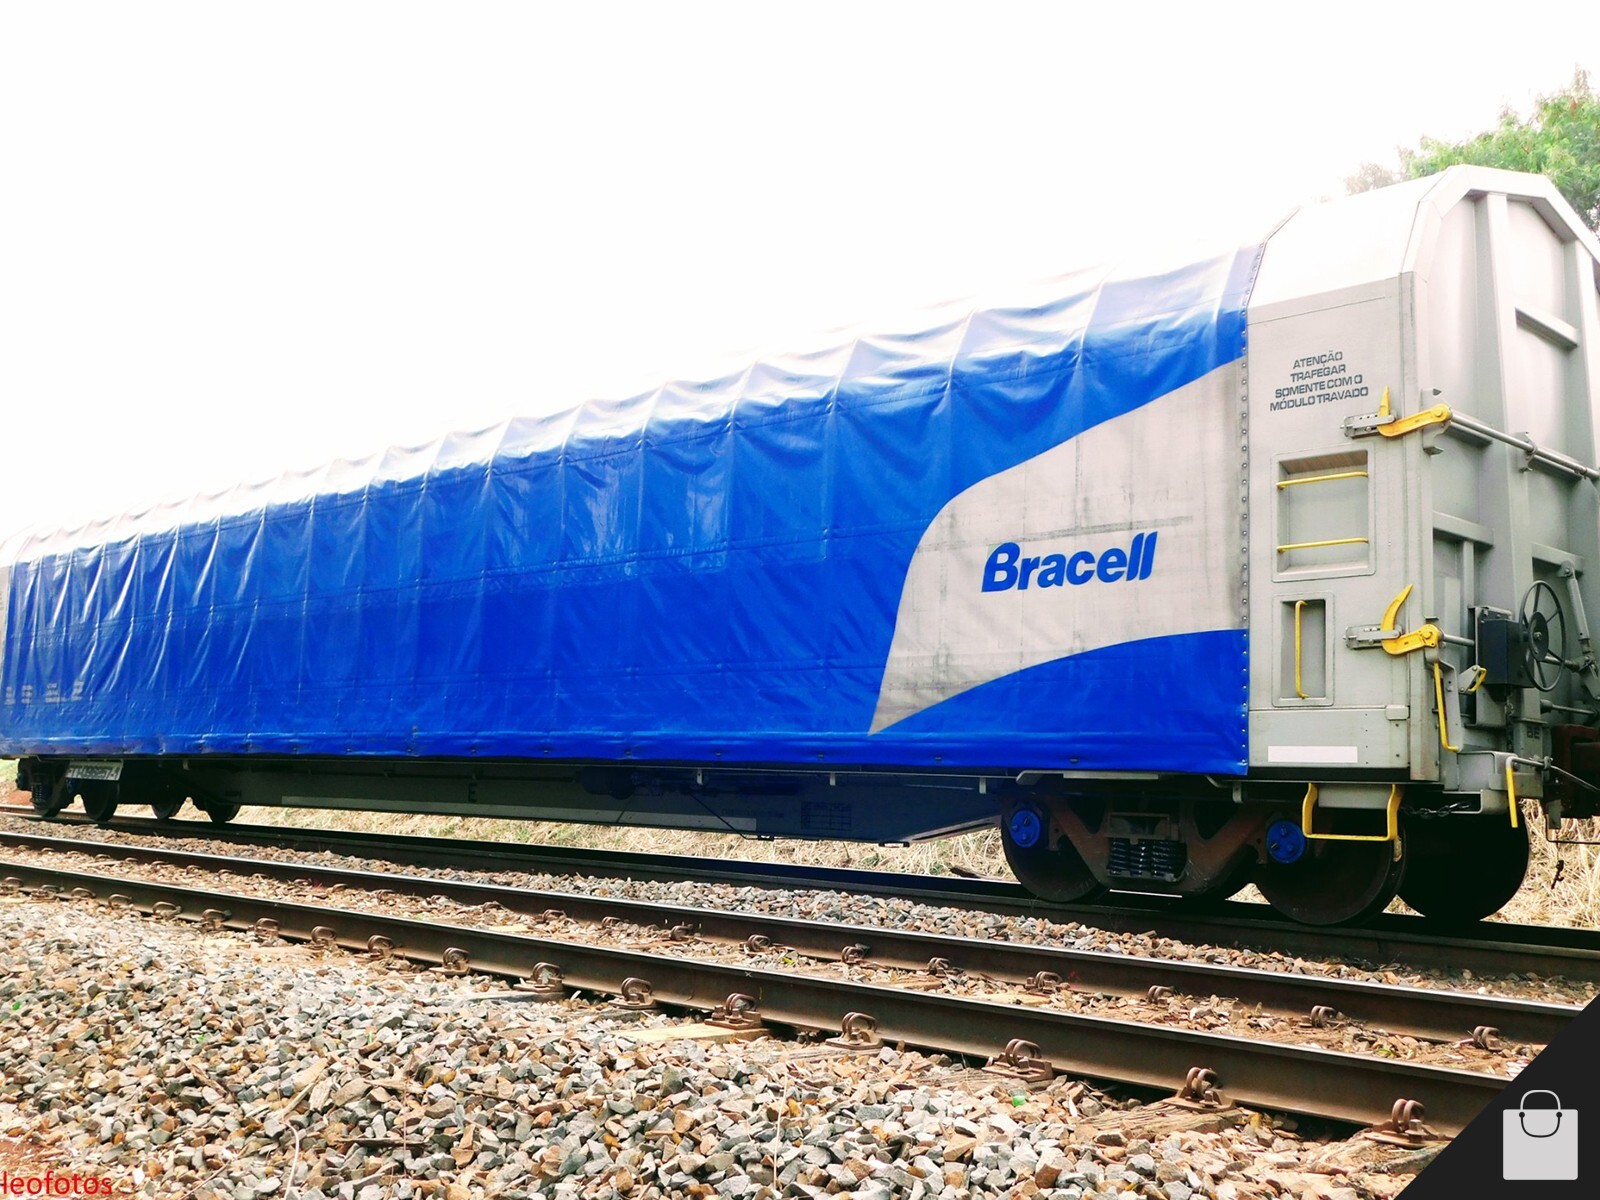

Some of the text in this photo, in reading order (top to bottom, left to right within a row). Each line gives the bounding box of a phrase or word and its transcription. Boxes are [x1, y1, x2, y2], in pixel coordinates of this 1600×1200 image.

[1293, 350, 1343, 369] ATENÇÃO
[1290, 364, 1346, 382] TRAFEGAR
[1275, 374, 1363, 398] SOMENTE COM O
[1270, 386, 1369, 412] MÓDULO TRAVADO
[981, 531, 1158, 592] Bracell
